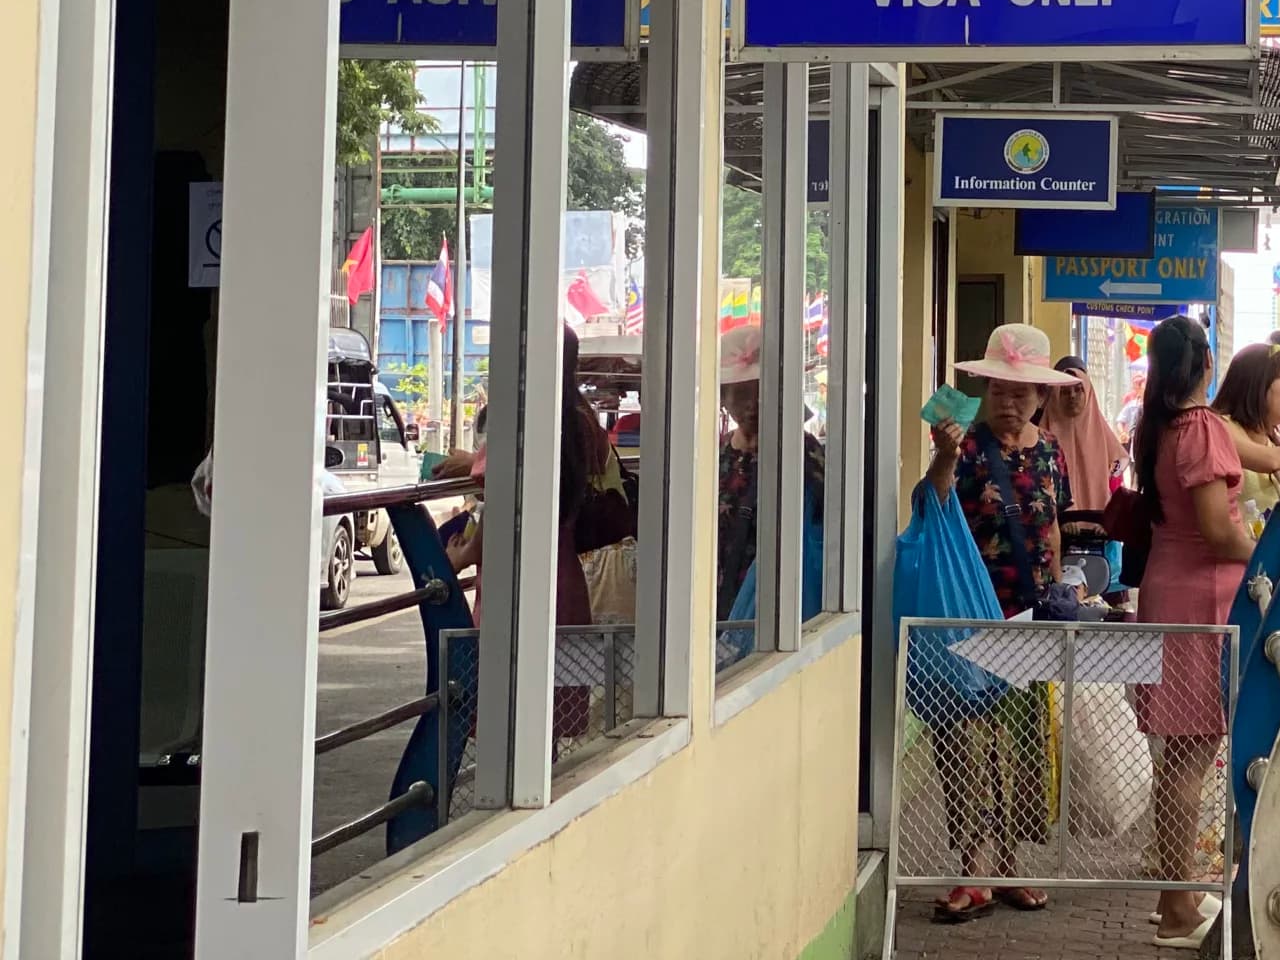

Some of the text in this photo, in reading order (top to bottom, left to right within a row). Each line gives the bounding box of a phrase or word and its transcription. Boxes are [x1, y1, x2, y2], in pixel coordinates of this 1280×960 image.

[954, 174, 1097, 193] Information Counter
[1155, 210, 1211, 225] GRATION
[1153, 232, 1175, 248] INT
[1056, 256, 1209, 279] PASSPORT ONLY
[1086, 302, 1155, 315] CUSTOMS CHECK POINT
